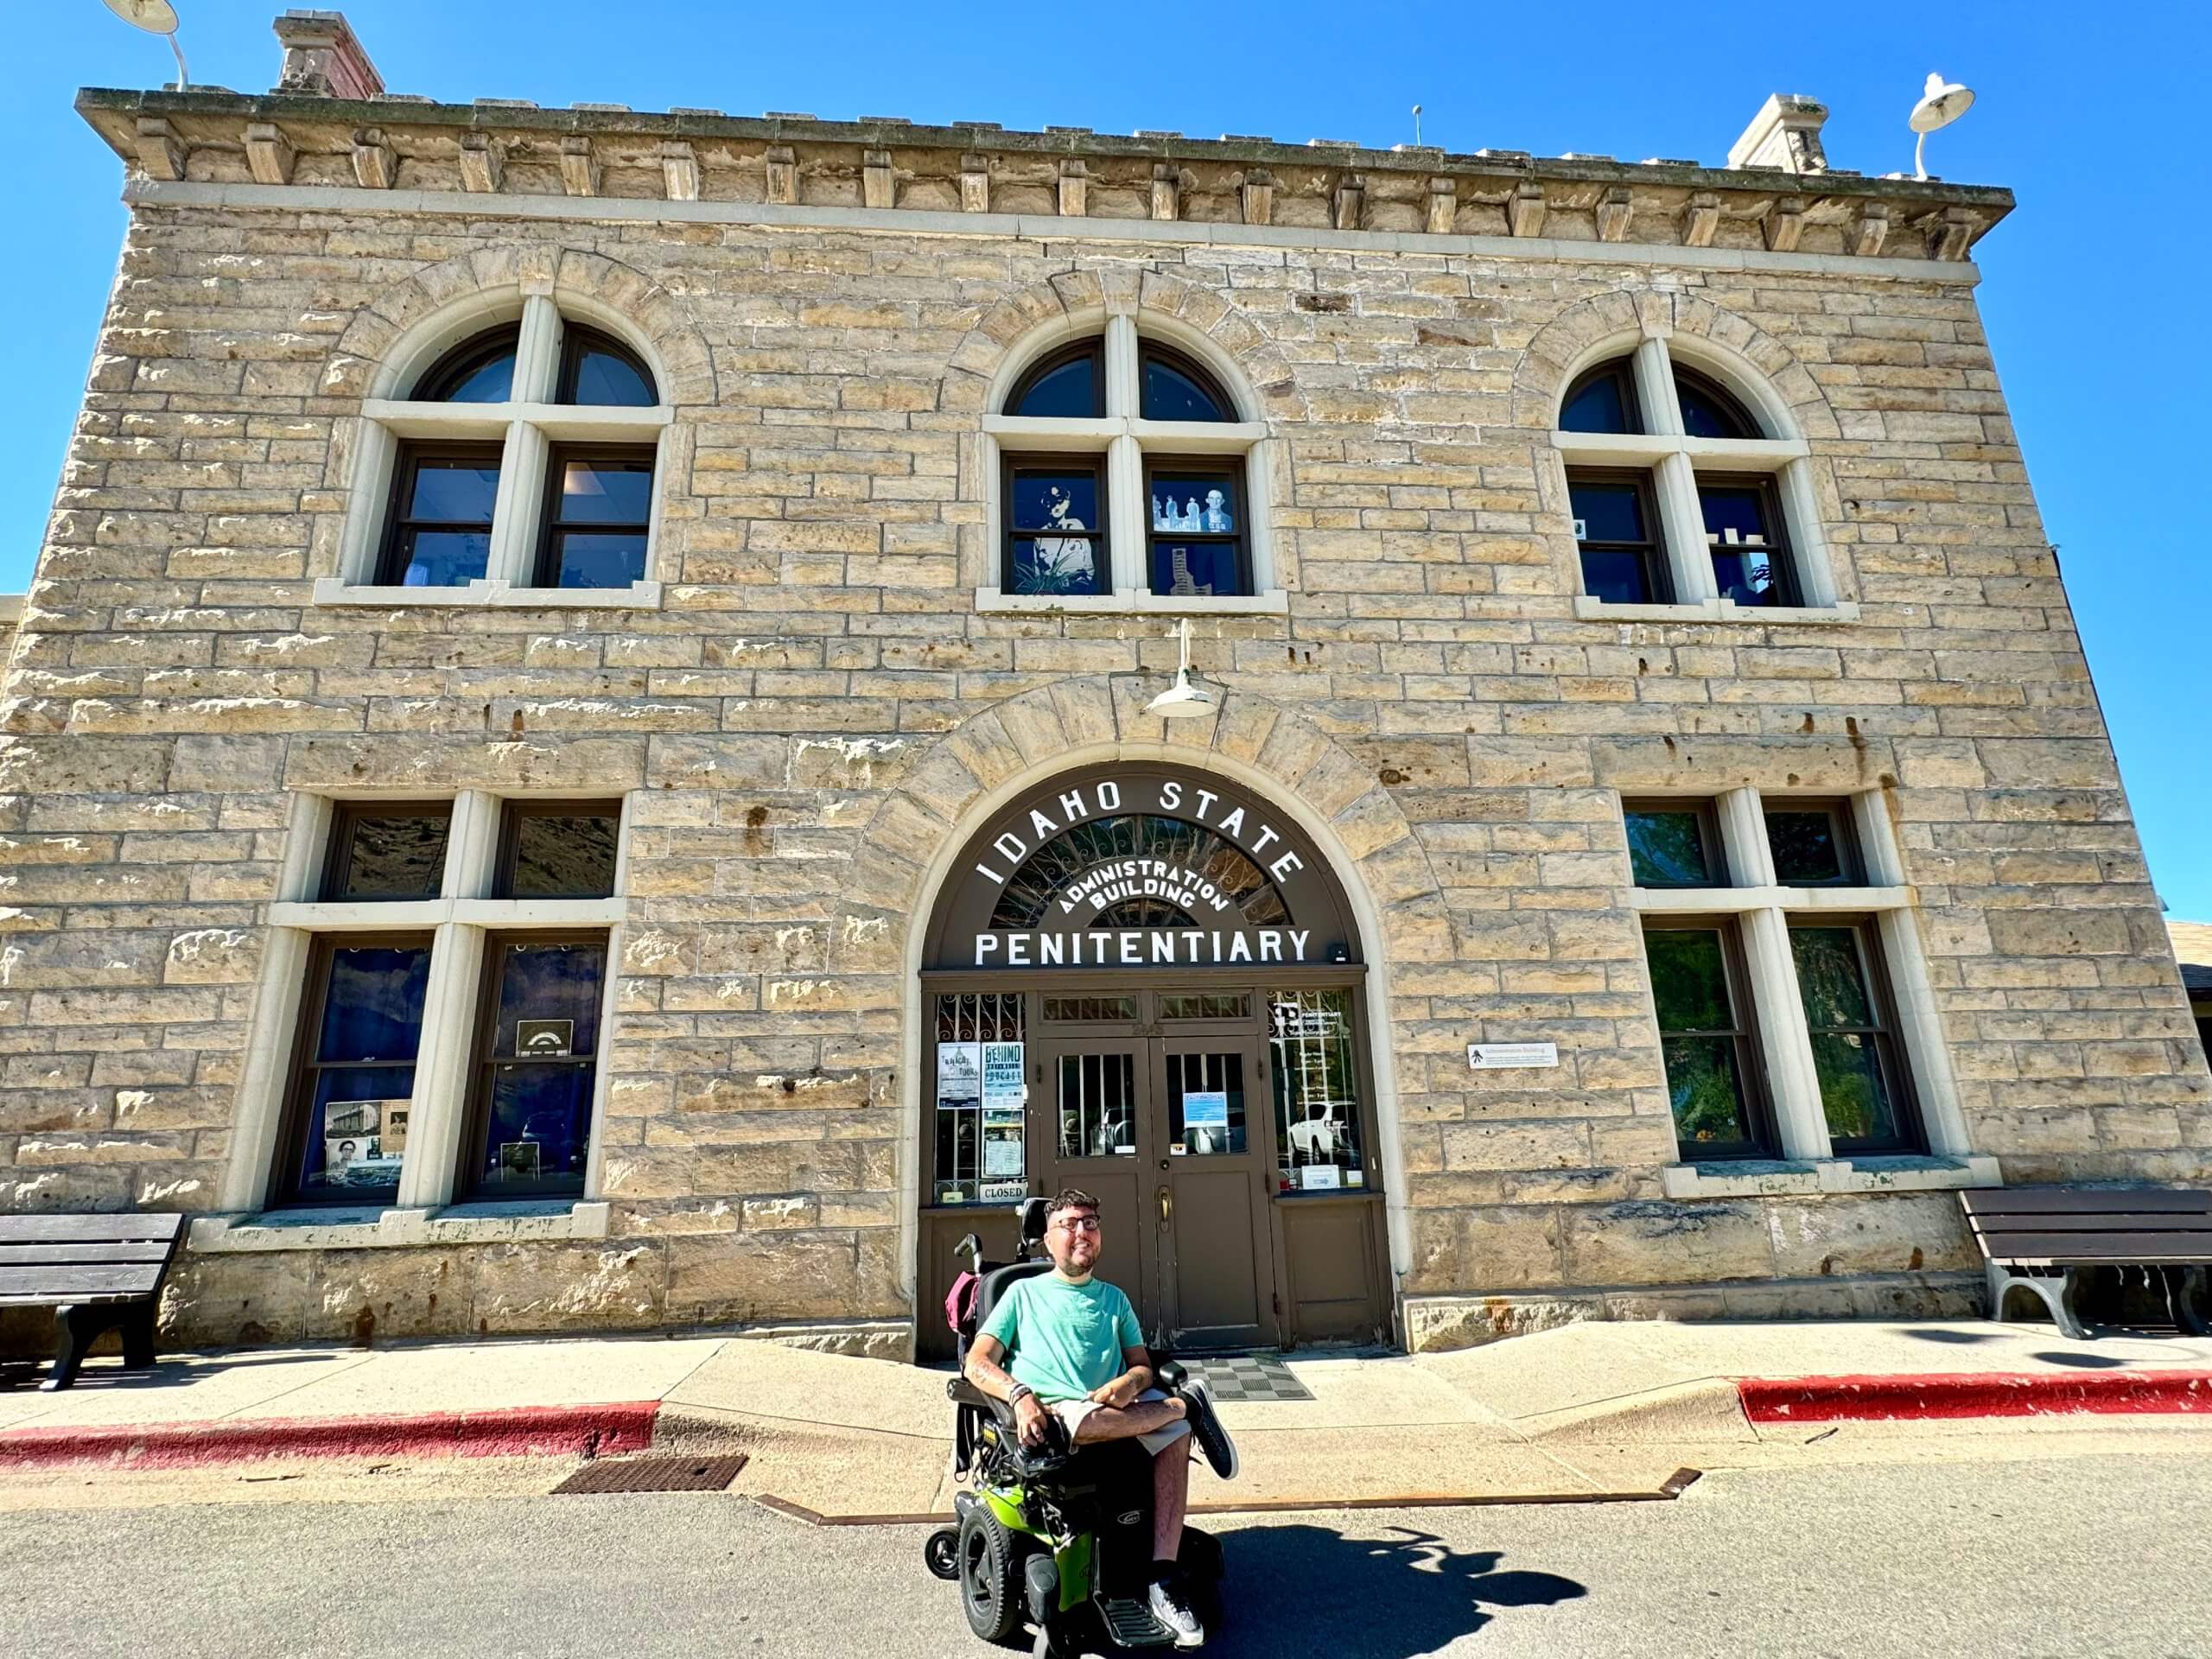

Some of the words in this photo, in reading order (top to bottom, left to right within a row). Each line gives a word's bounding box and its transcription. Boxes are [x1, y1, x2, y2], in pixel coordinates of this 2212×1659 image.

[976, 780, 1121, 885] IDAHO
[1159, 781, 1305, 884] STATE
[1058, 859, 1230, 914] ADMINISTRATION
[1088, 878, 1197, 911] BUILDING
[975, 930, 1311, 965] PENITENTIARY
[985, 1045, 1020, 1063] BEHIND
[984, 1187, 1023, 1198] CLOSED
